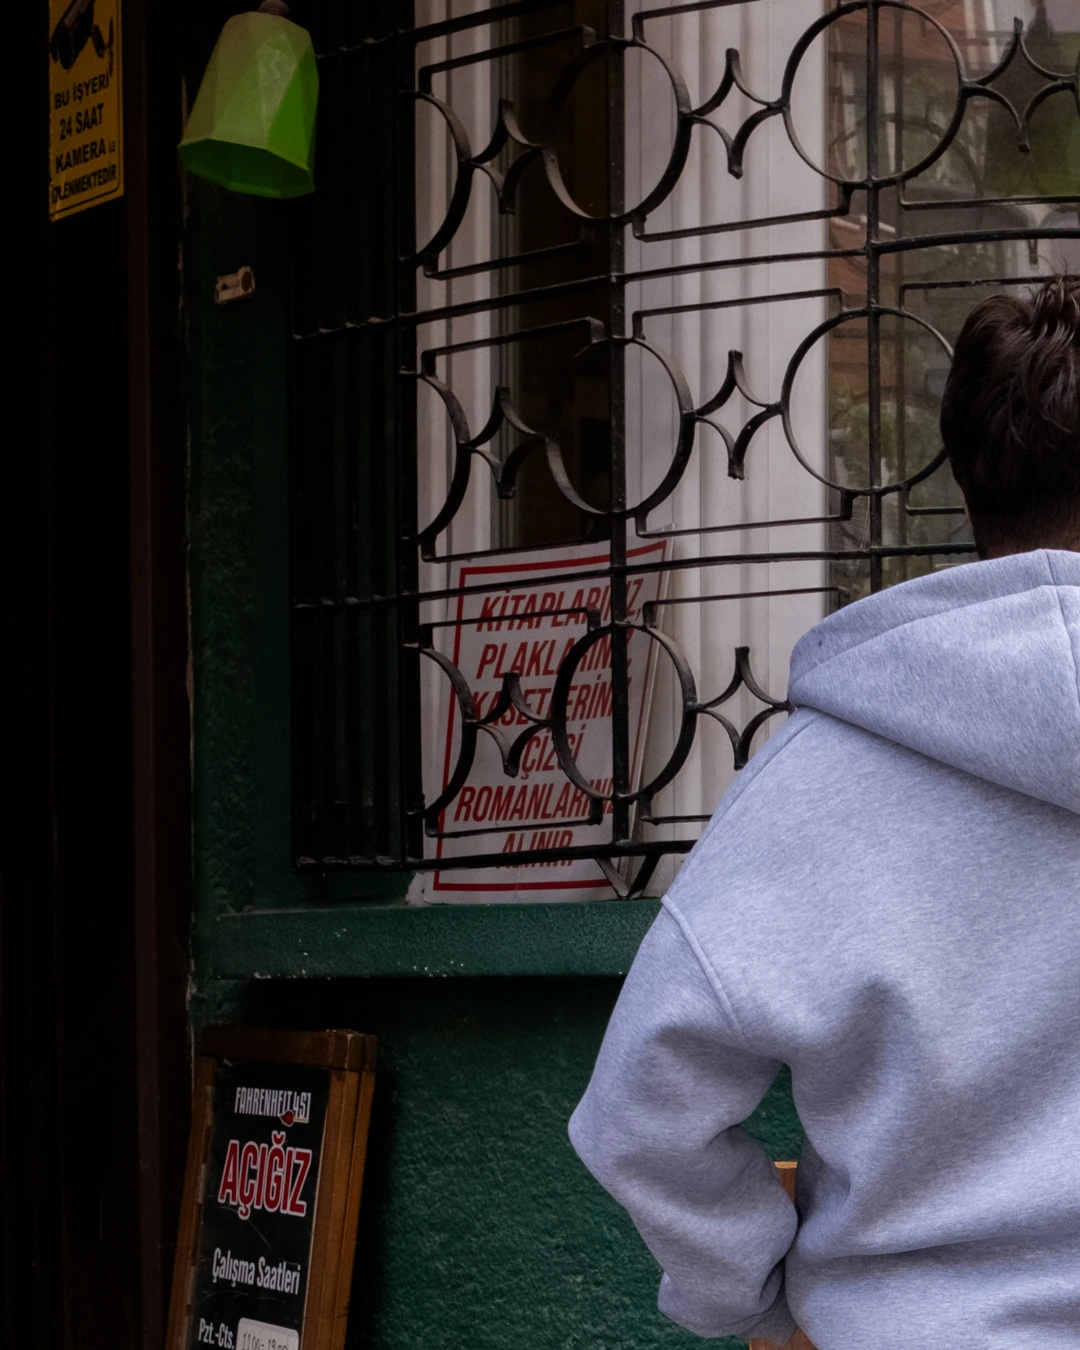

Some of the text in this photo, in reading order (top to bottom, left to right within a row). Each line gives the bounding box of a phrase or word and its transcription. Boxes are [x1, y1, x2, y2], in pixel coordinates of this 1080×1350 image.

[55, 89, 69, 110] BU
[59, 103, 104, 141] 24 SAAT
[55, 138, 105, 173] KAMERA
[218, 1130, 312, 1220] AÇIĞIZ
[212, 1247, 301, 1295] Çalışma Saatleri
